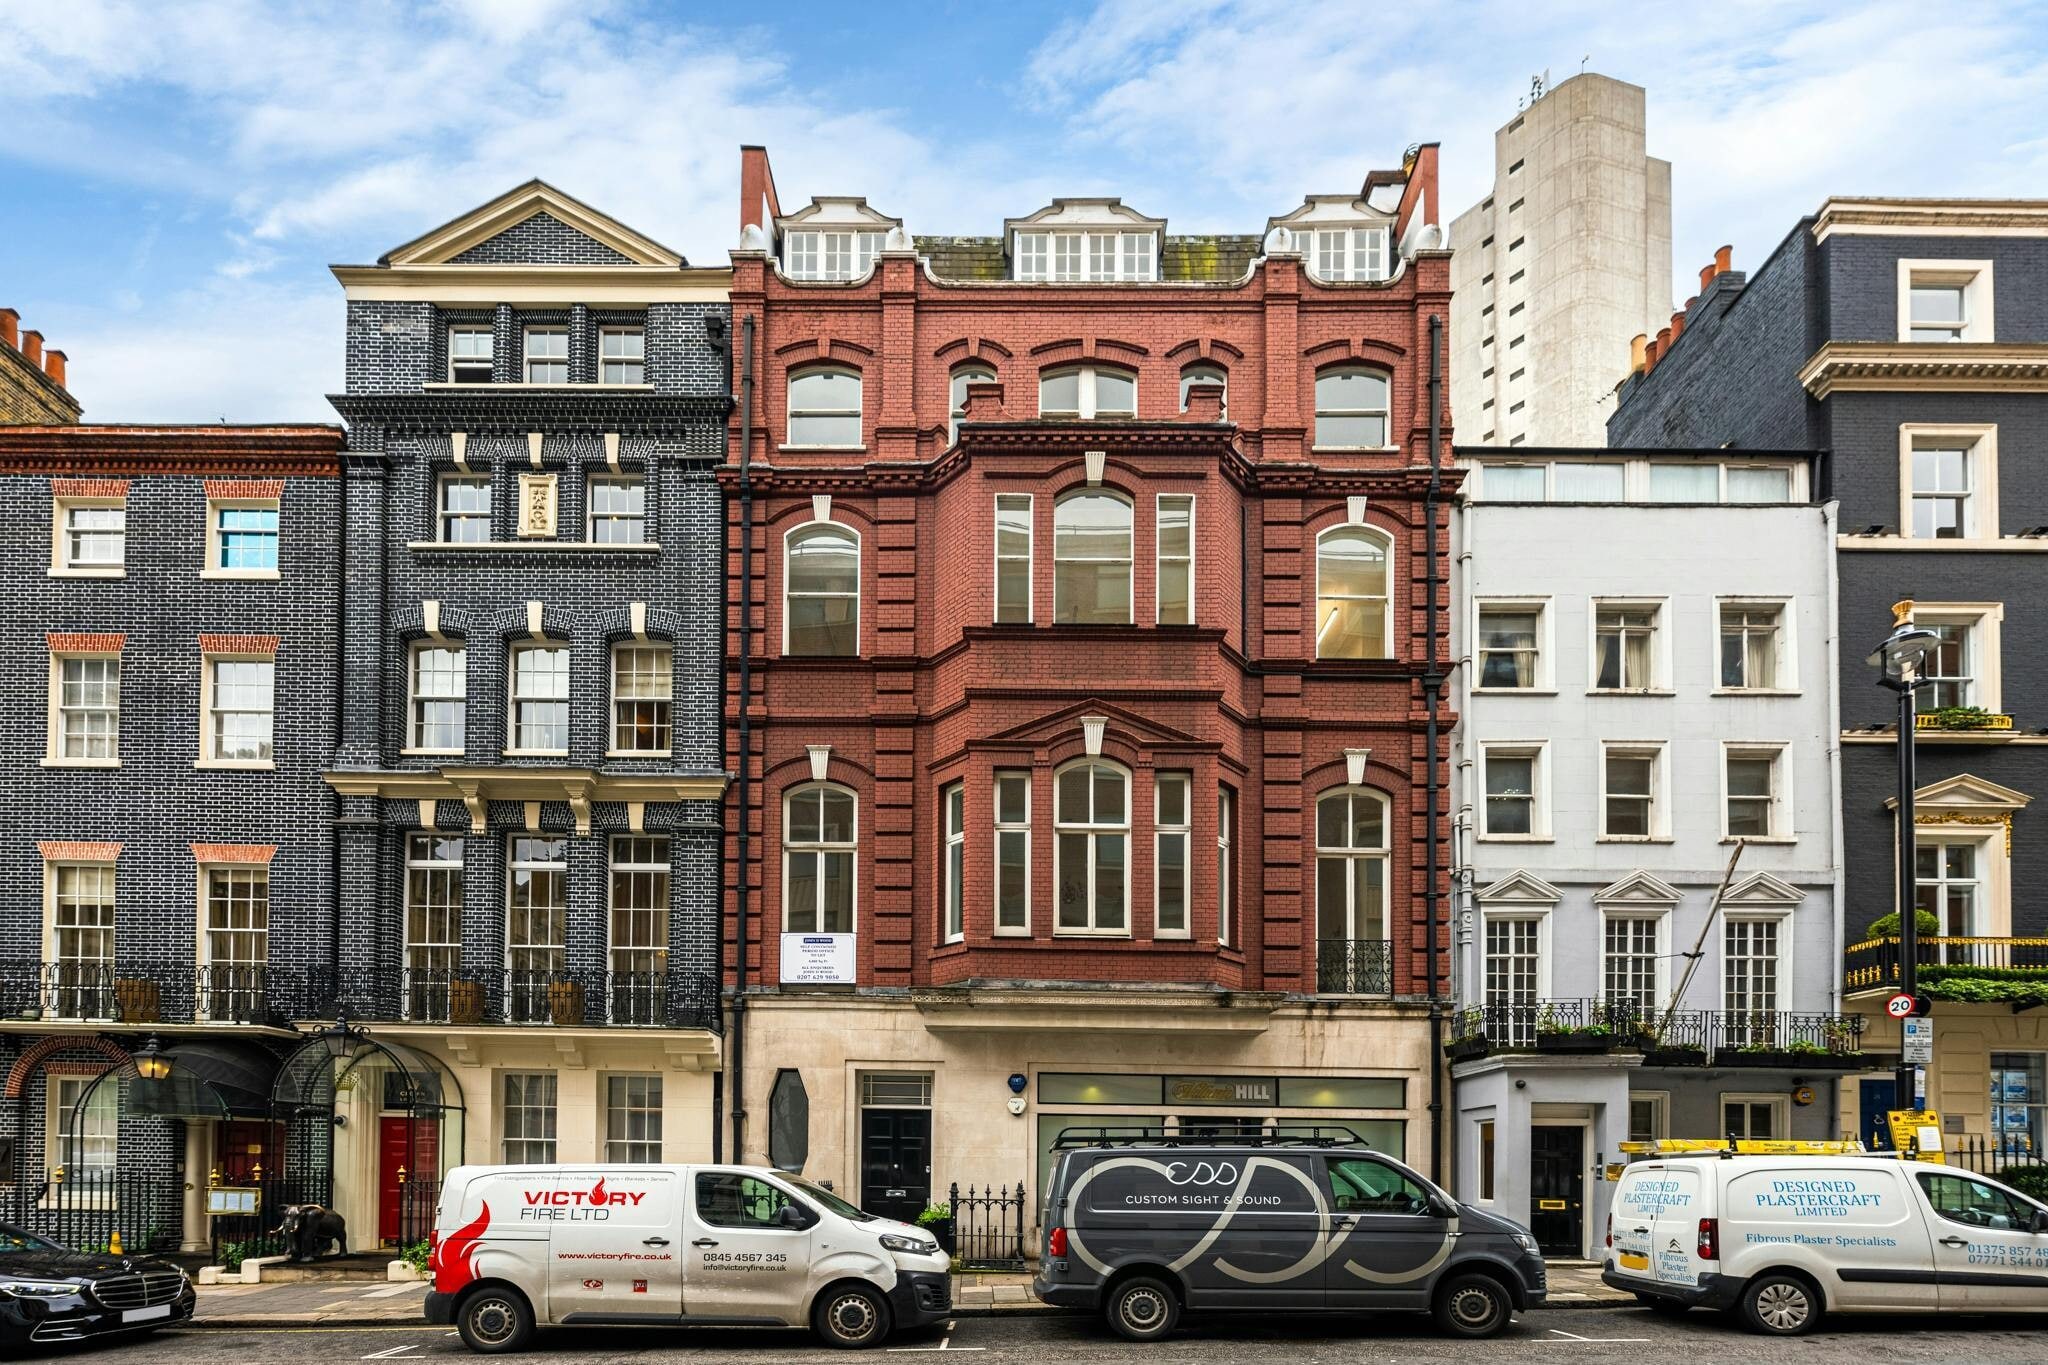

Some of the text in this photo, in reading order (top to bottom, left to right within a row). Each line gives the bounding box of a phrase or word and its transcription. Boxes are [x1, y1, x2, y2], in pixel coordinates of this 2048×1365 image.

[1891, 1001, 1910, 1012] 20
[1235, 1084, 1270, 1099] HILL
[1634, 1181, 1679, 1193] DESIGNED
[1773, 1181, 1856, 1193] DESIGNED
[524, 1186, 646, 1206] VICTORY
[1125, 1195, 1281, 1205] CUSTOM SIGHT & SOUND
[1624, 1192, 1691, 1207] PLASTERCRAFT
[1756, 1194, 1880, 1207] PLASTERCRAFT
[520, 1208, 610, 1220] FIRE LTD
[1637, 1204, 1665, 1214] LIMITED
[1795, 1207, 1848, 1217] LIMITED
[1746, 1233, 1897, 1247] Fibrous Plaster Specialists
[1968, 1244, 2006, 1255] 01375
[2009, 1246, 2032, 1256] 857
[558, 1252, 672, 1261] www.victoryfire.co.uk
[703, 1253, 787, 1262] 0845 4567 345
[1659, 1251, 1688, 1263] Fibrous
[1968, 1255, 2006, 1266] 07771
[2009, 1257, 2032, 1267] 544
[703, 1264, 787, 1272] info@victoryfire.co.uk
[1662, 1261, 1688, 1272] Plaster
[1657, 1271, 1697, 1283] Specialists
